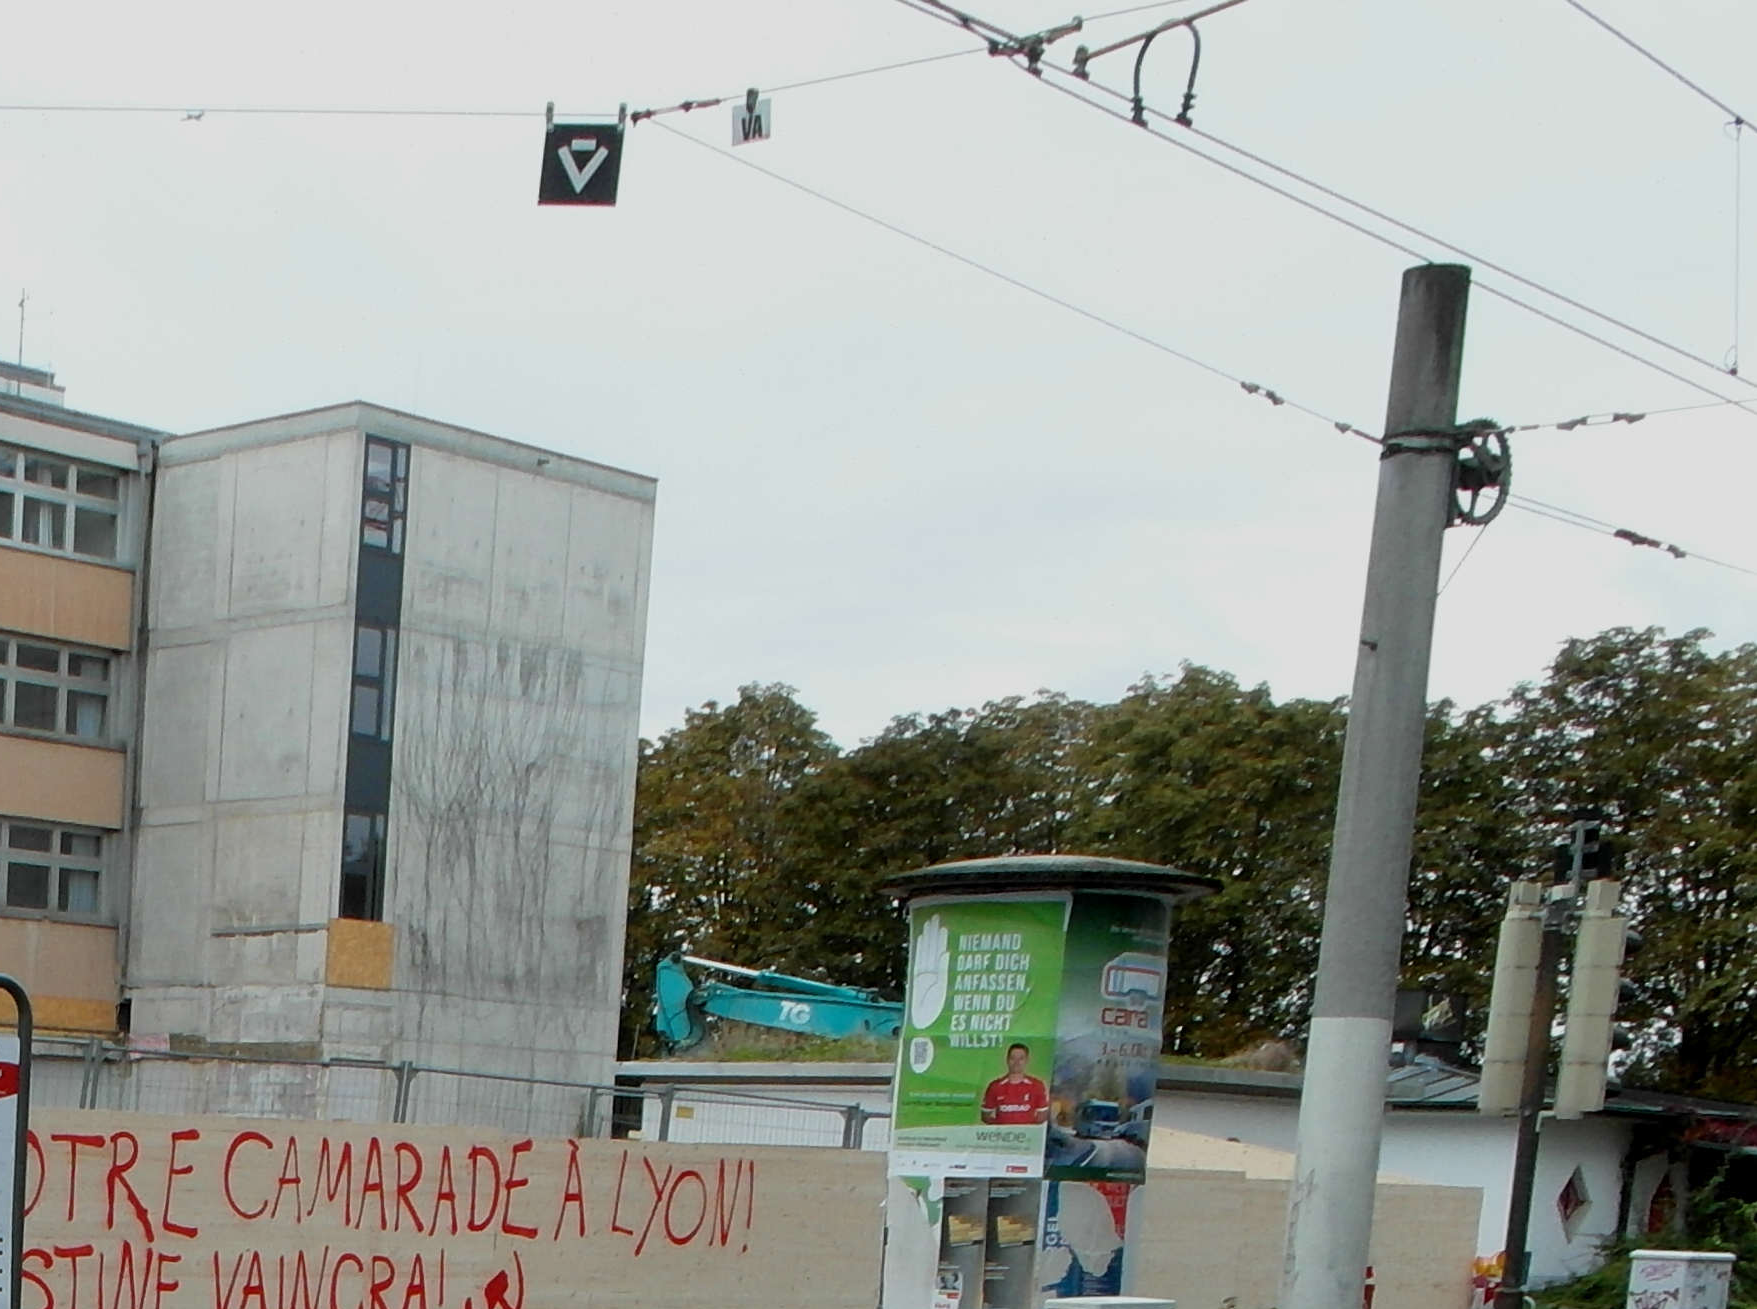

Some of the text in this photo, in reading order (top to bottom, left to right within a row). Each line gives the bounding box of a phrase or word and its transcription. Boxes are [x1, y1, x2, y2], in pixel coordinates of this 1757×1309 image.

[741, 114, 763, 141] VA
[958, 934, 1021, 951] NIEMAND
[956, 954, 1030, 971] DARF DICH
[954, 974, 1031, 993] ANFASSEN,
[953, 994, 1016, 1011] WENN DU
[950, 1014, 1012, 1031] ES NICHT
[949, 1033, 1004, 1048] WILLST!
[223, 1131, 540, 1240] CAMARADE
